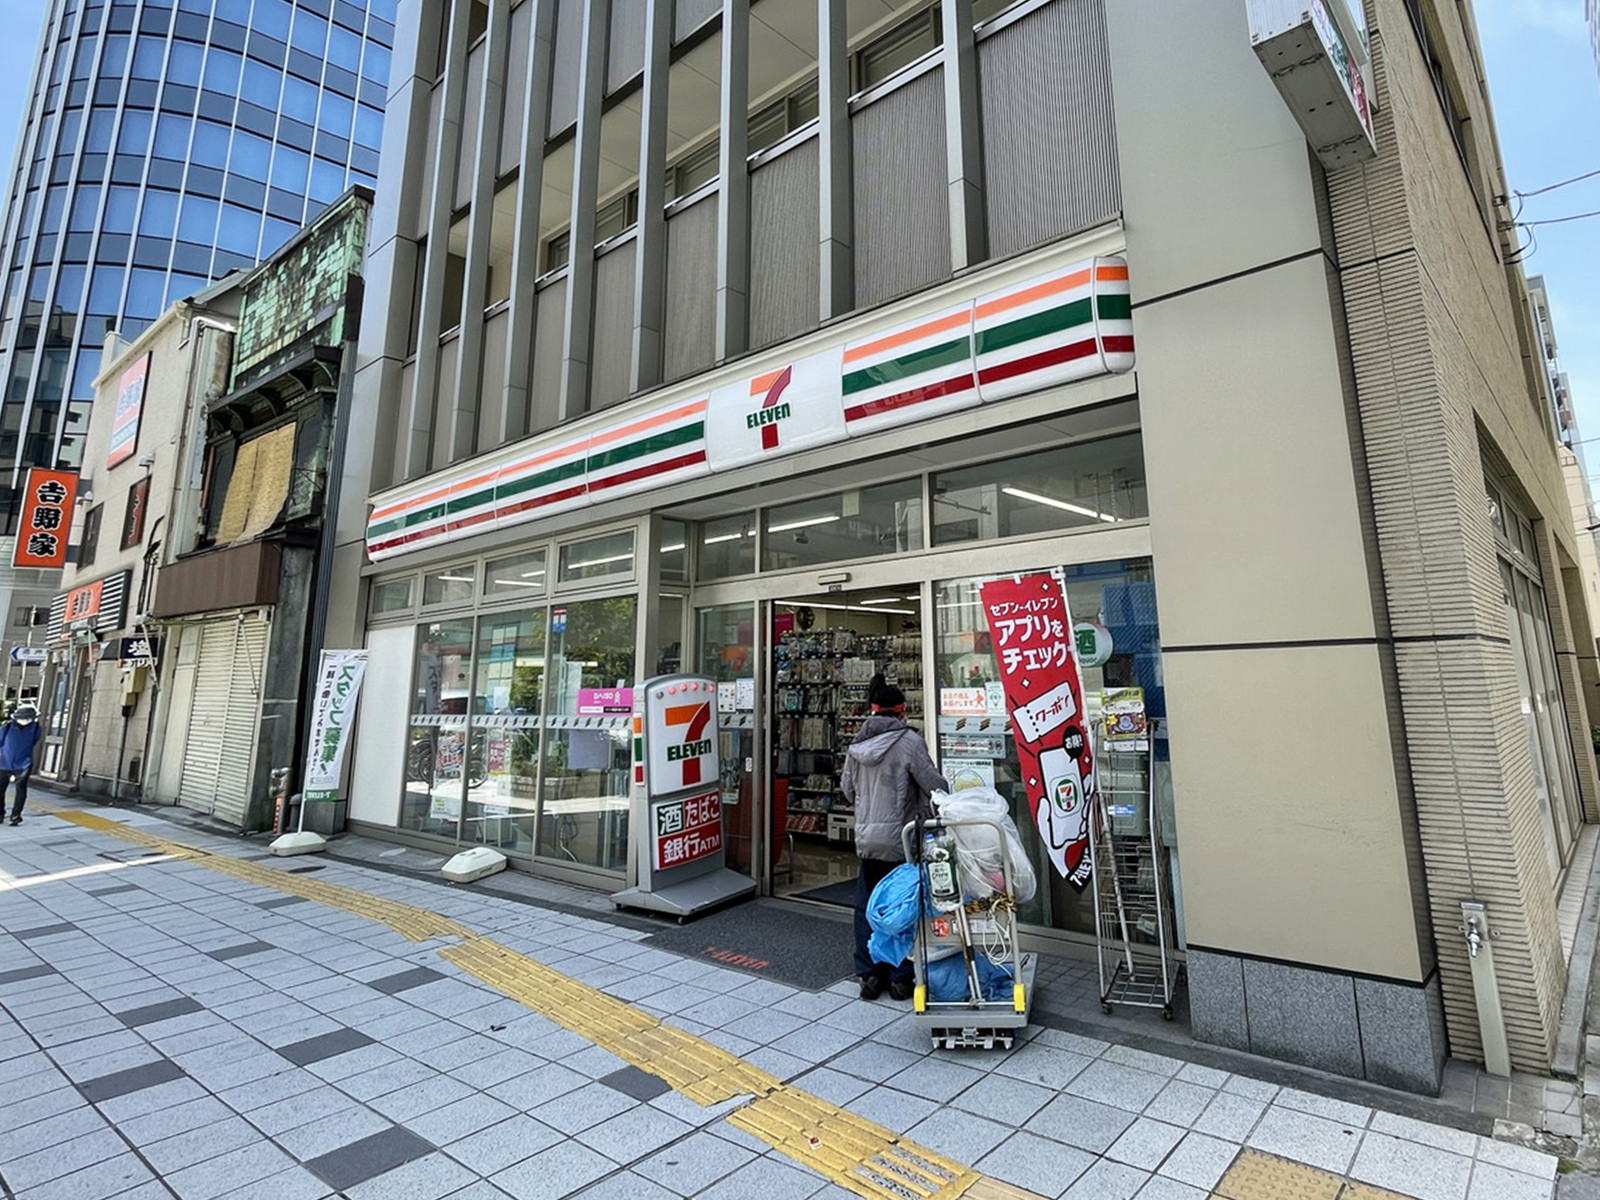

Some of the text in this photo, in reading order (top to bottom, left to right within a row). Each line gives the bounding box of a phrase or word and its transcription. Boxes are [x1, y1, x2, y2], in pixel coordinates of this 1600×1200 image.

[26, 480, 67, 557] 吉野家
[990, 597, 1058, 617] セブン-イレブン
[994, 614, 1064, 646] アプリを
[1002, 641, 1068, 675] チェック
[659, 804, 683, 835] 酒
[685, 795, 720, 828] たばこ
